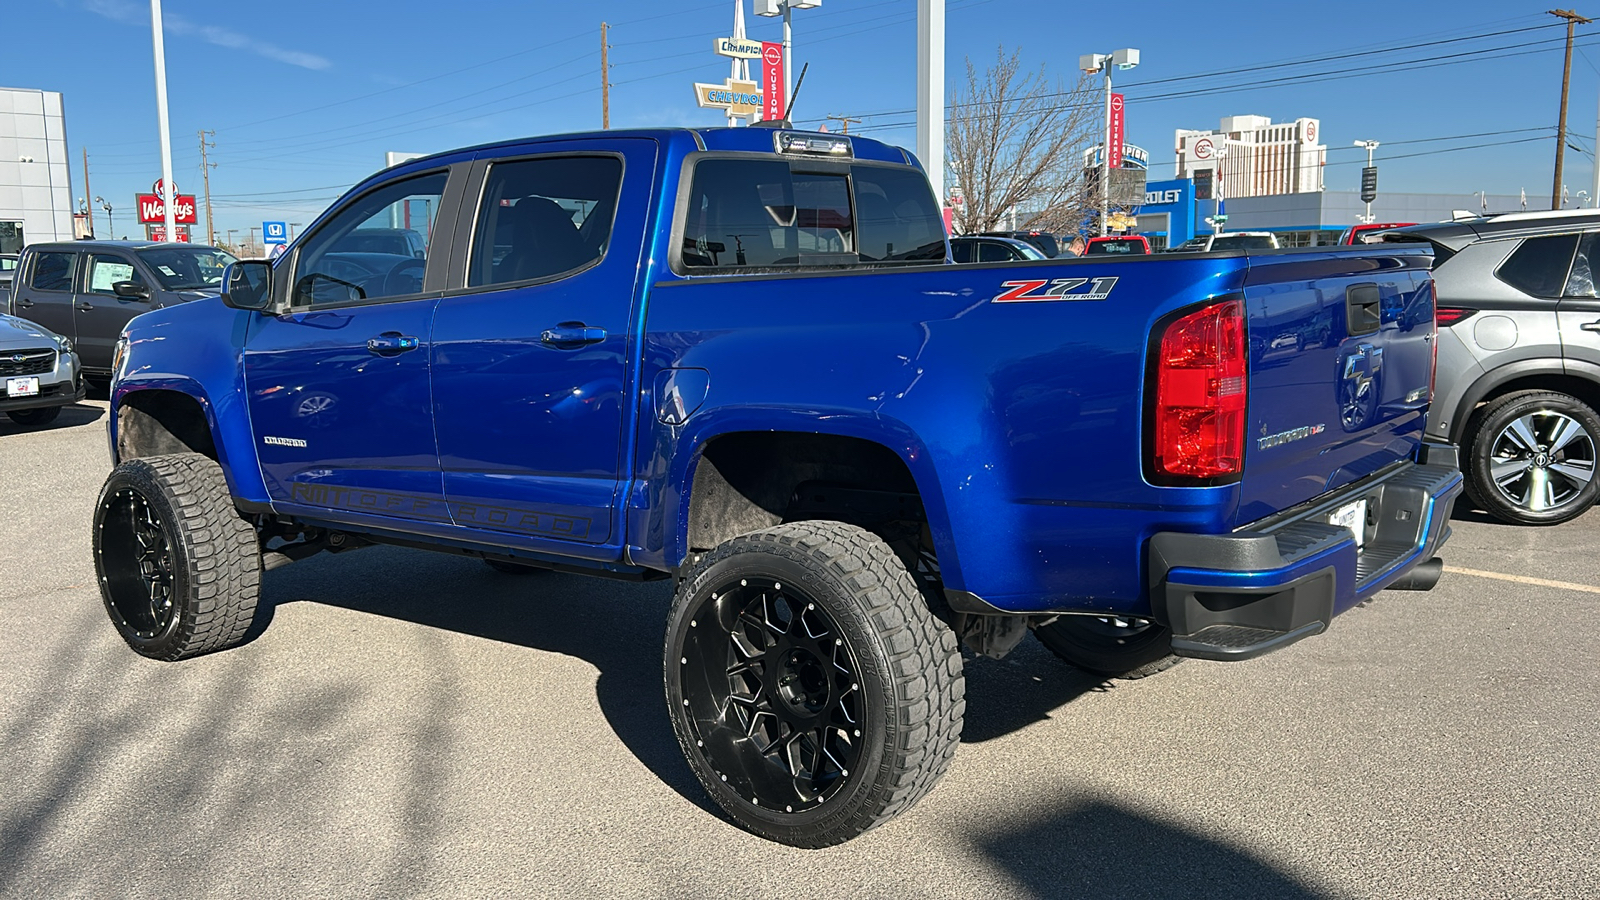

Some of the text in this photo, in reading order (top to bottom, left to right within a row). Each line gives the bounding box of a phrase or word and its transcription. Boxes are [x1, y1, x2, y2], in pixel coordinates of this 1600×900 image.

[991, 277, 1119, 303] Z71
[360, 494, 429, 512] OFF
[458, 505, 573, 532] ROAD
[801, 572, 877, 676] GLADIATOR
